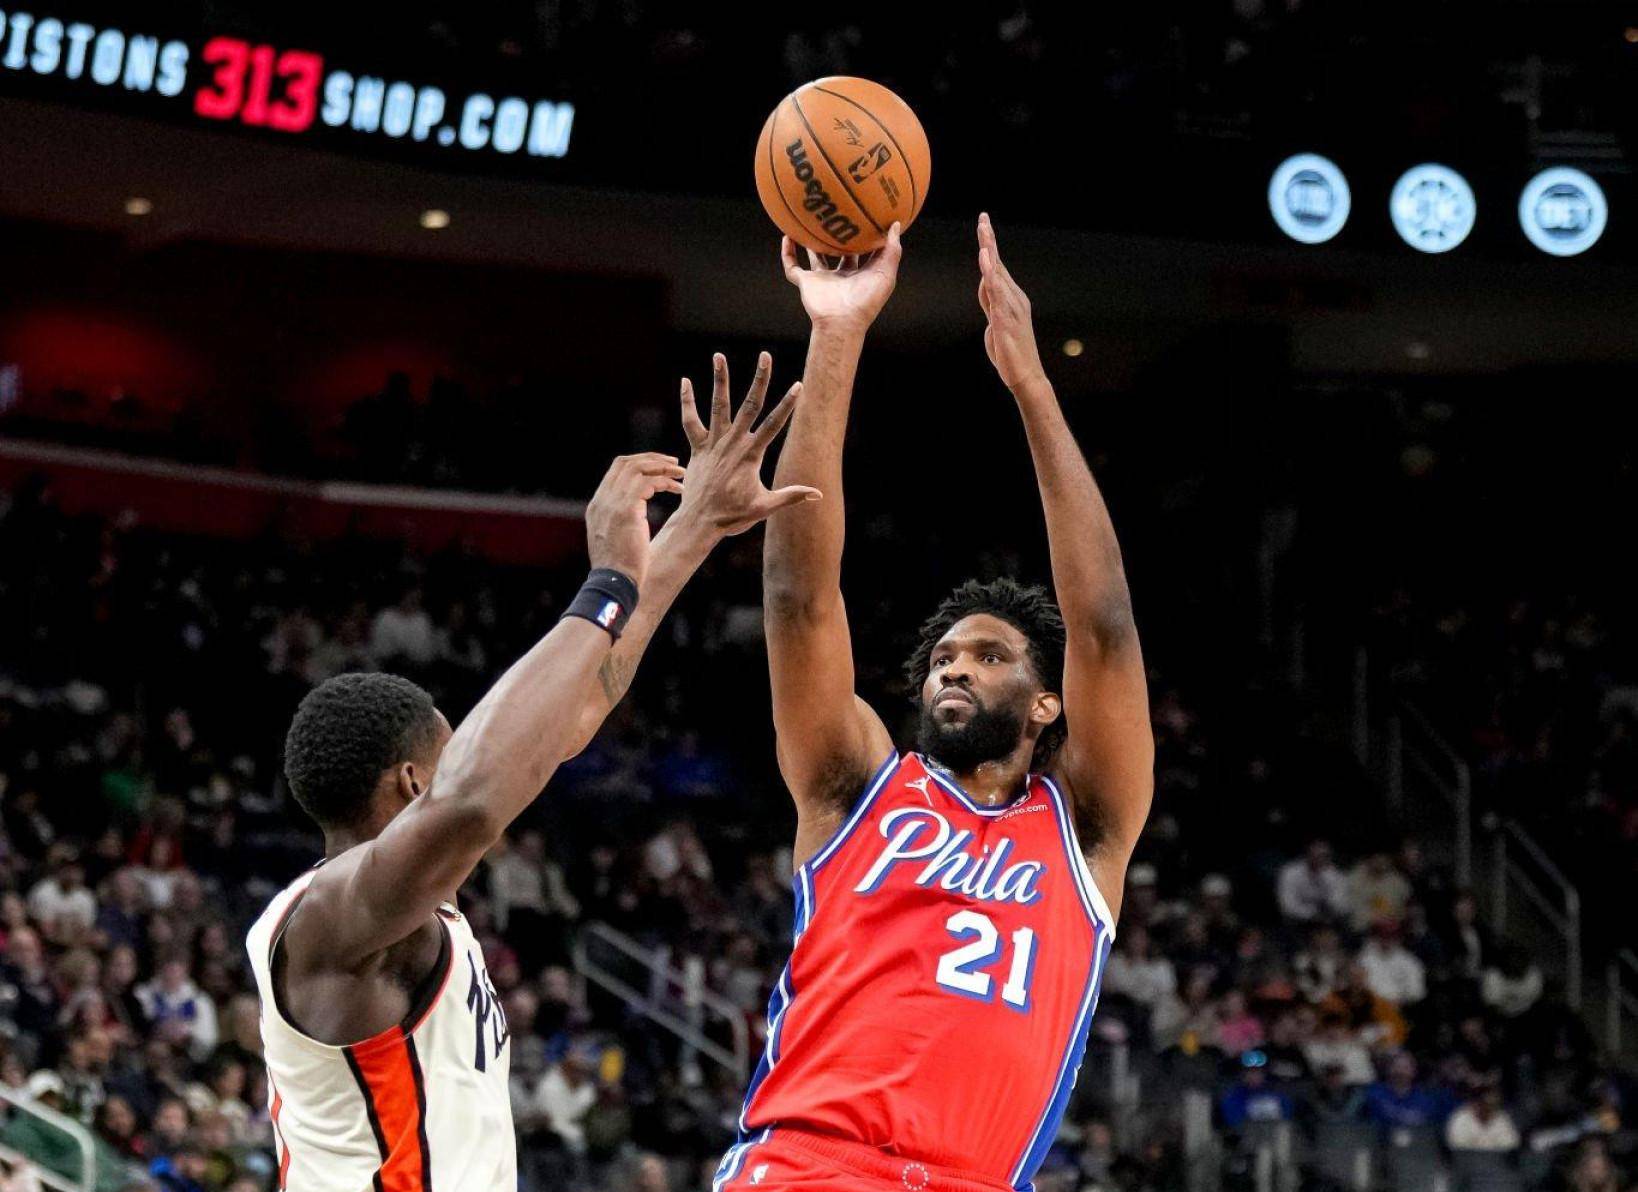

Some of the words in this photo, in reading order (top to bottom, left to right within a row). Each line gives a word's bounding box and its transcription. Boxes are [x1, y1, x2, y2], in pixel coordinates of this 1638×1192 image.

[0, 10, 190, 97] ISTONS
[194, 36, 325, 133] 313
[321, 70, 577, 158] SHOP.COM
[786, 139, 860, 245] Wilson
[853, 807, 1047, 904] Phila
[935, 910, 1038, 1014] 21
